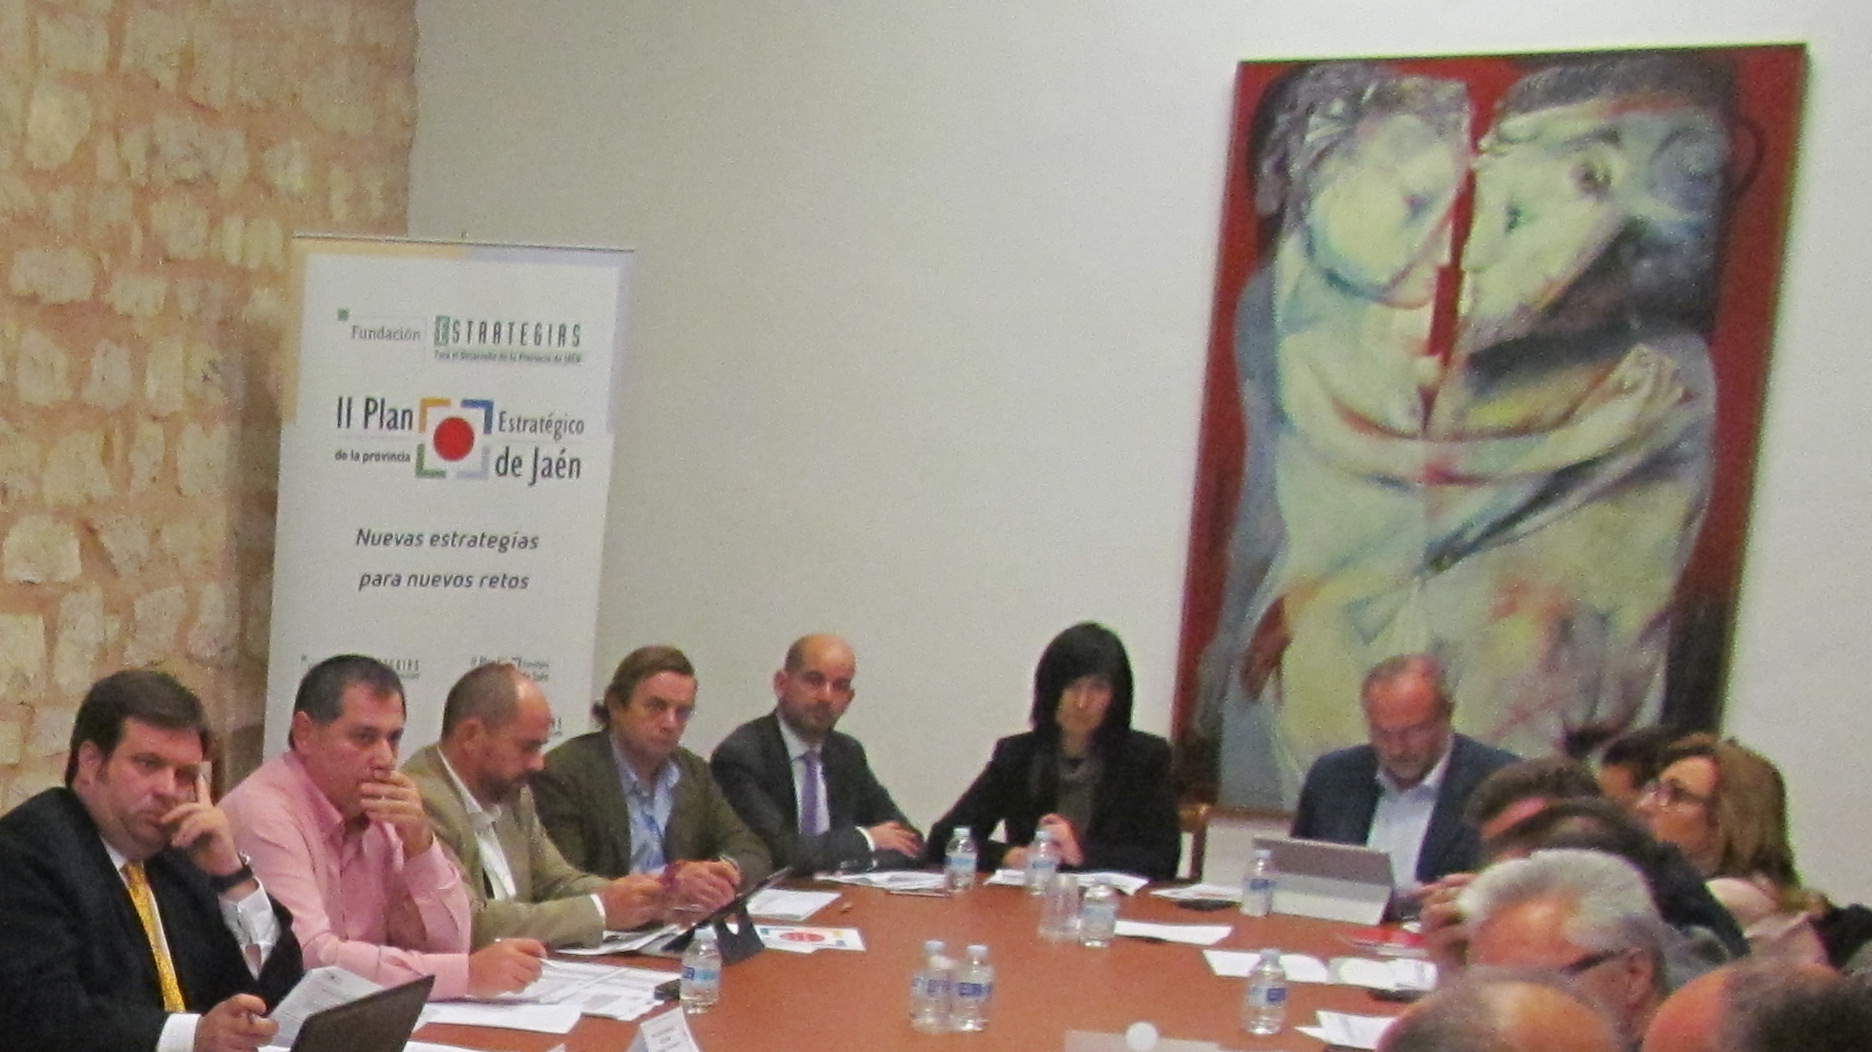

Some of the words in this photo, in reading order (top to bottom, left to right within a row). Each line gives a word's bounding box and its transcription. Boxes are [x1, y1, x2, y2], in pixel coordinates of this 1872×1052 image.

[351, 325, 421, 342] Fundación
[434, 315, 582, 348] ESTRATEGIAS
[337, 396, 352, 430] II
[364, 397, 413, 431] Plan
[499, 410, 585, 439] Estratégico
[335, 449, 348, 461] de
[350, 449, 359, 462] la
[362, 450, 412, 463] provincia
[495, 446, 523, 477] de
[528, 446, 582, 486] Jaén
[356, 528, 423, 548] Nuevas
[430, 530, 539, 553] estrategias
[359, 572, 401, 592] para
[407, 573, 473, 588] nuevos
[479, 573, 530, 589] retos
